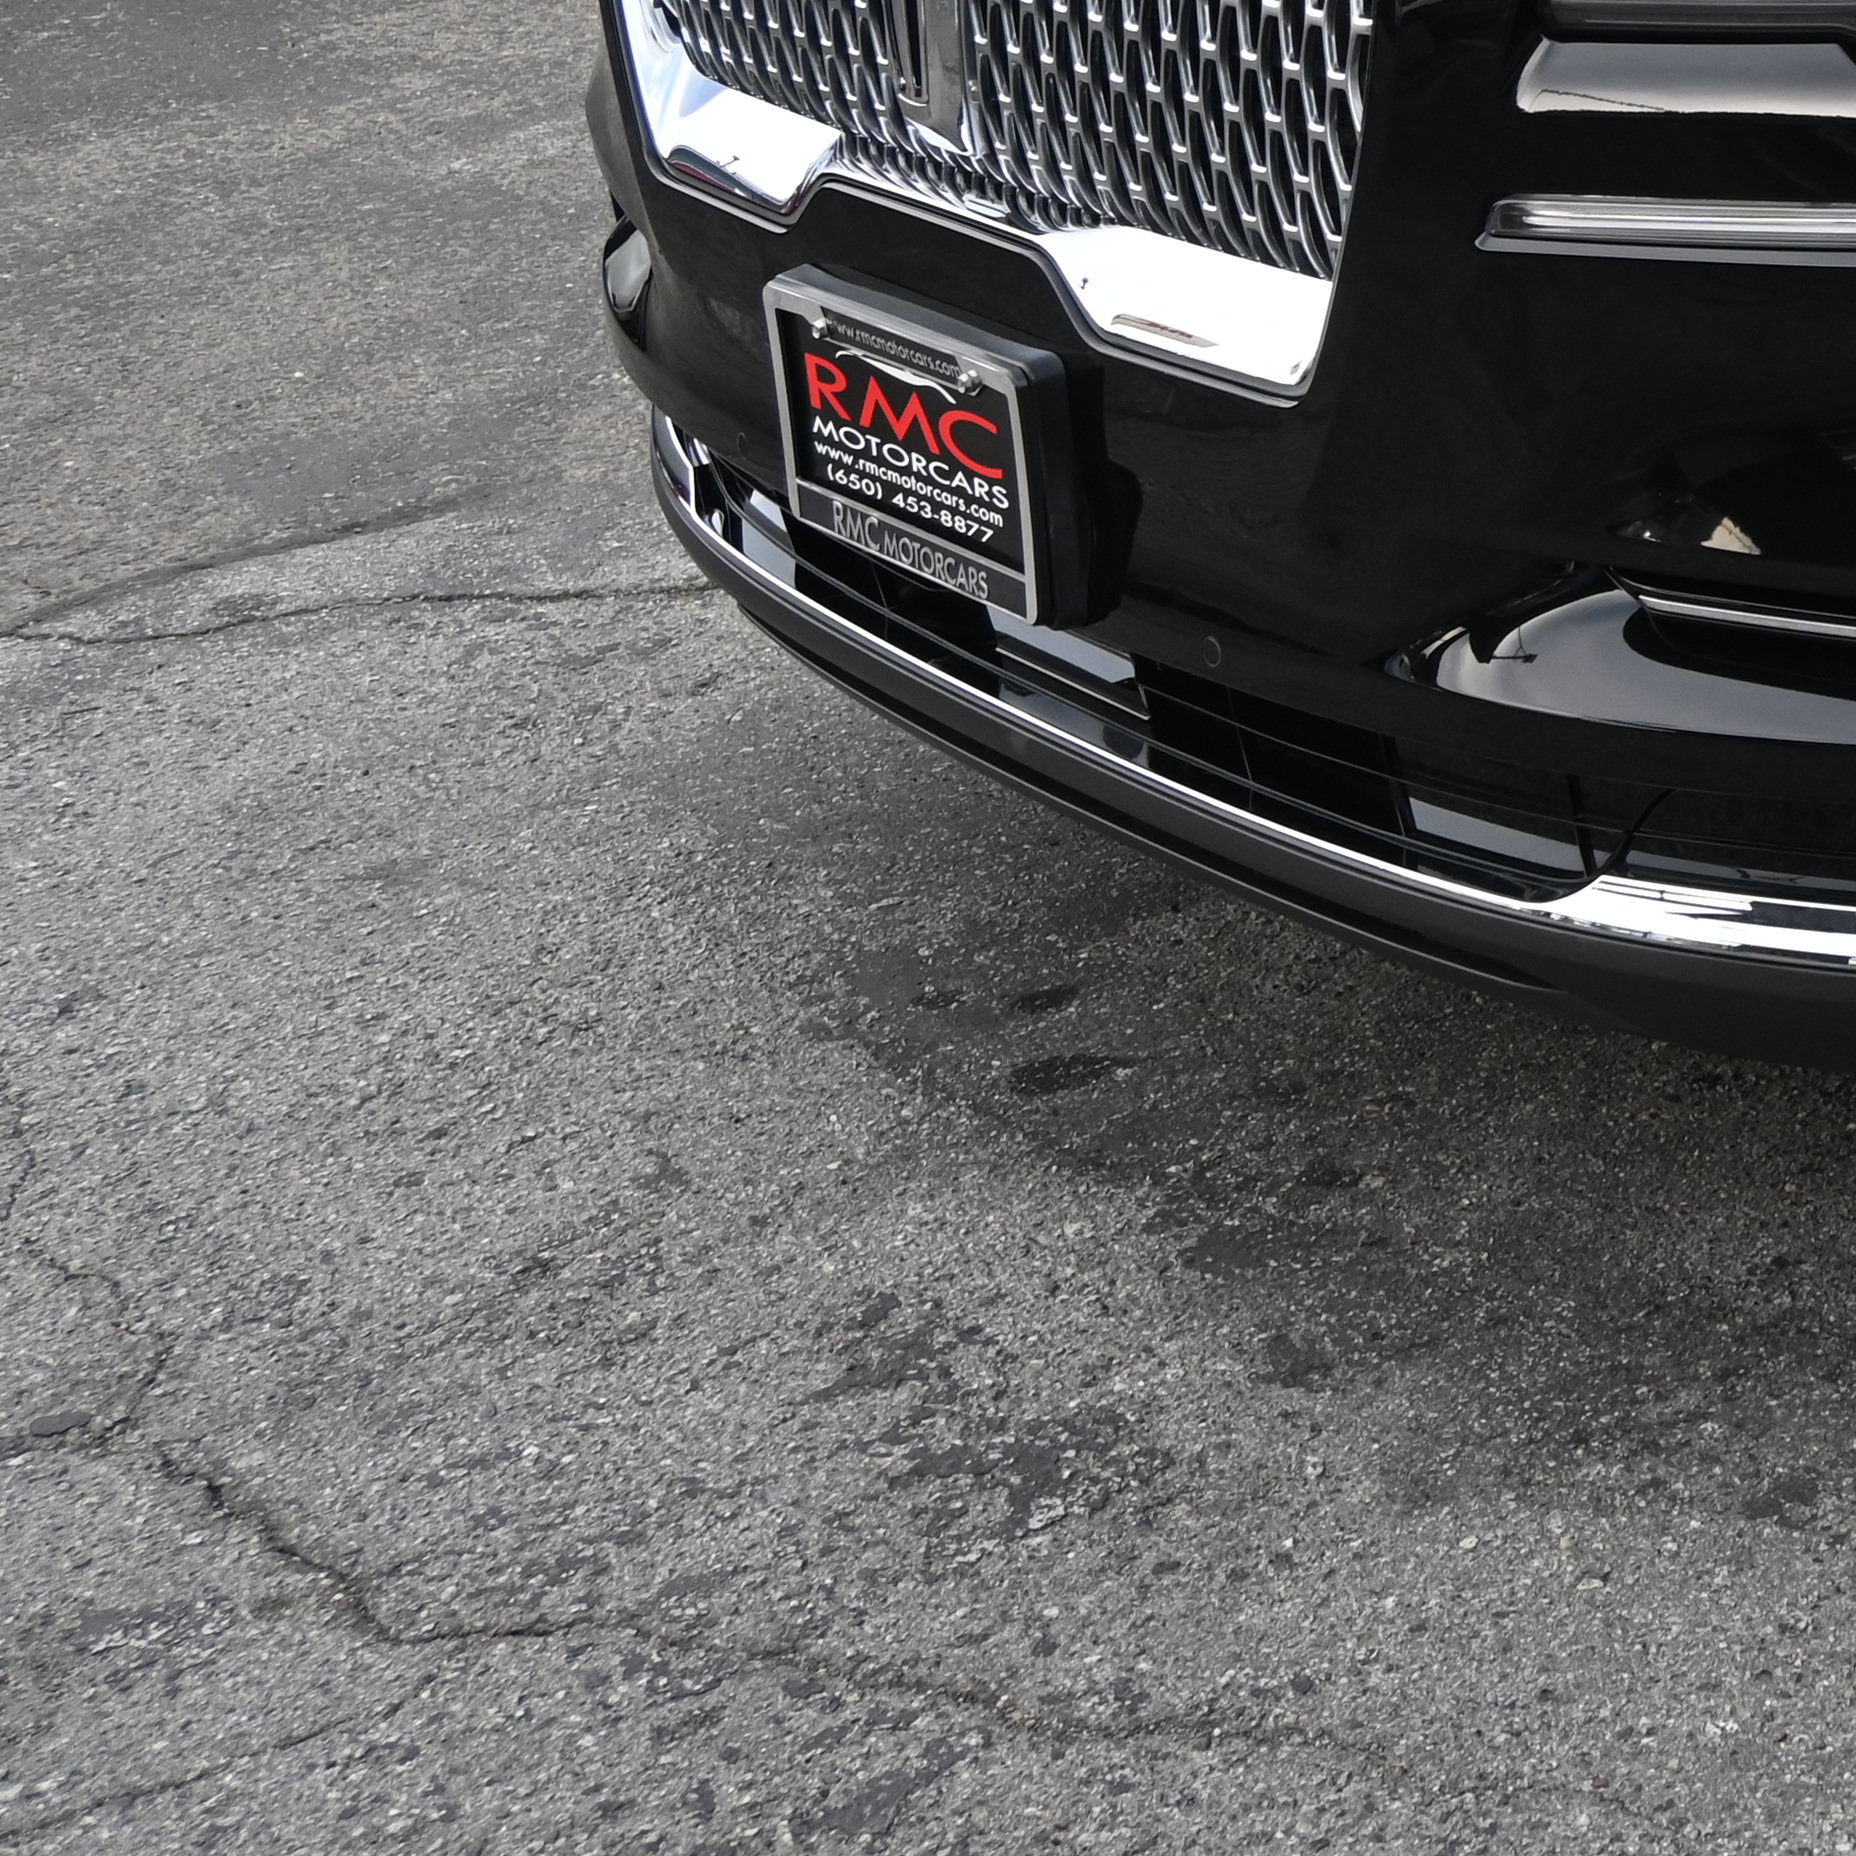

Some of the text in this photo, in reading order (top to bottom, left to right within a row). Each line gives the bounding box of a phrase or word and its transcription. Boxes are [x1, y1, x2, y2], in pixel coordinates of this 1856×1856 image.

[804, 352, 1004, 479] RMC
[812, 415, 1010, 509] MOTORCARS
[814, 440, 1004, 527] www.rmcmotorcars.com
[827, 463, 994, 543] (650) 453-8877
[832, 500, 989, 600] RMC MOTORCARS
